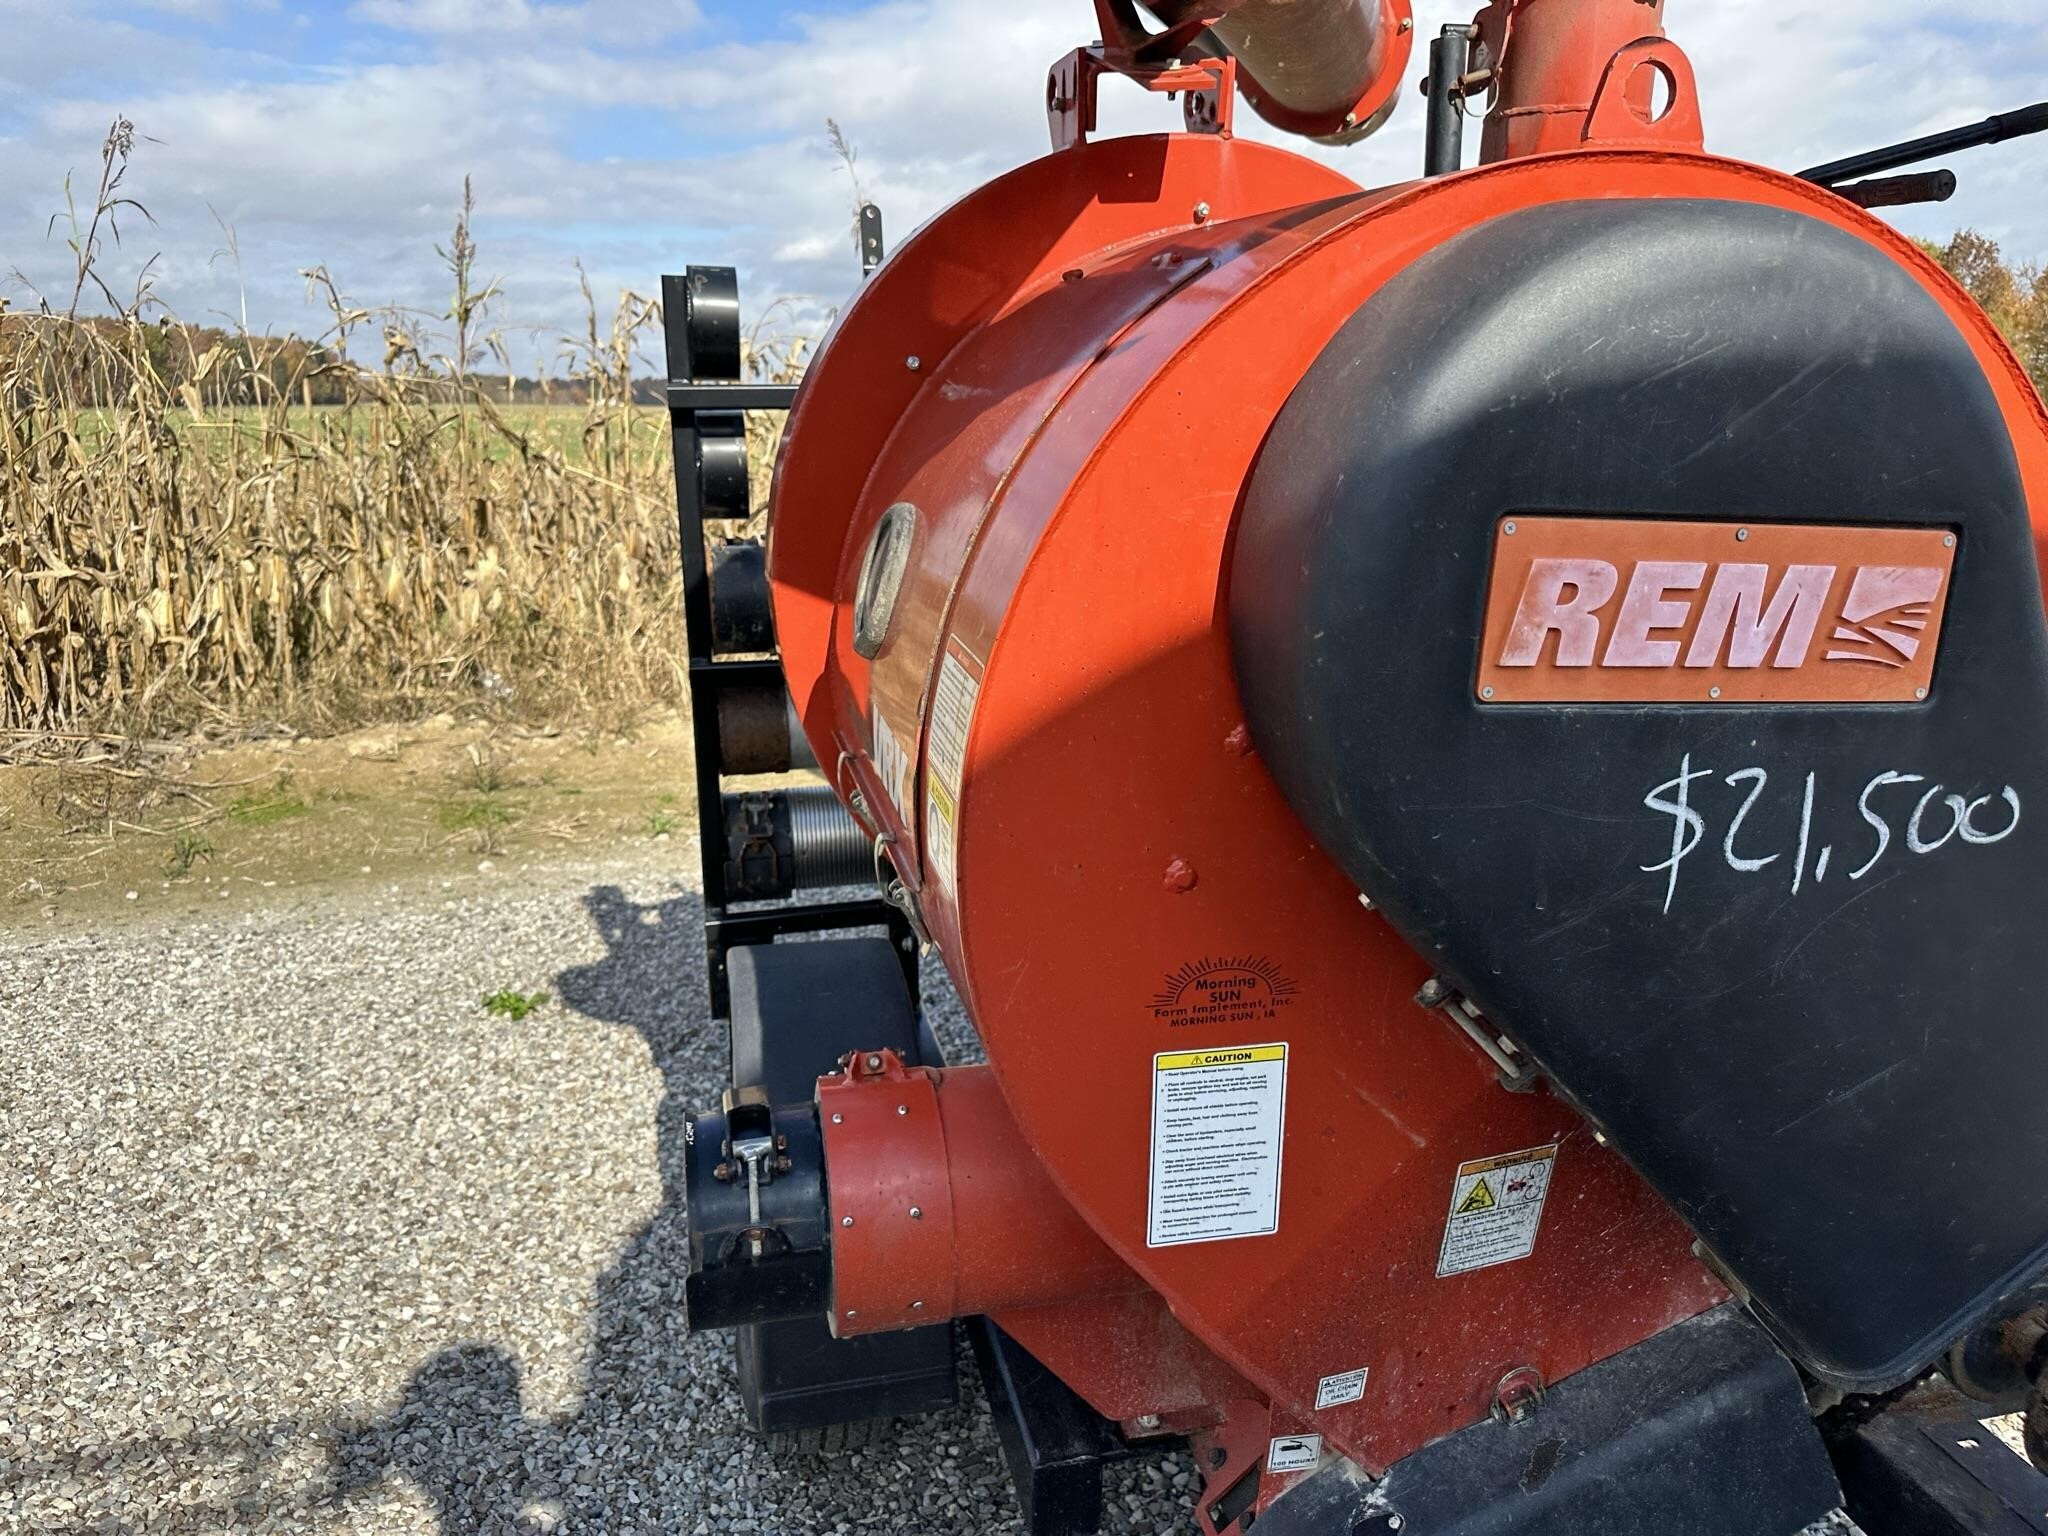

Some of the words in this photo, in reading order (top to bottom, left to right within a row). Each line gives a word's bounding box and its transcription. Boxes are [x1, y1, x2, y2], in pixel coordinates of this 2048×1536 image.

[1496, 557, 1837, 669] REM
[1639, 752, 2021, 915] $21,500
[1195, 976, 1256, 991] Morning
[1209, 990, 1241, 1003] SUN
[1154, 1008, 1188, 1018] Farm
[1192, 999, 1267, 1015] Implement,
[1271, 996, 1295, 1007] Inc.
[1170, 1014, 1227, 1028] MORNING
[1264, 1008, 1276, 1019] IA
[1204, 1052, 1252, 1064] CAUTION
[1288, 1457, 1316, 1465] HOURS
